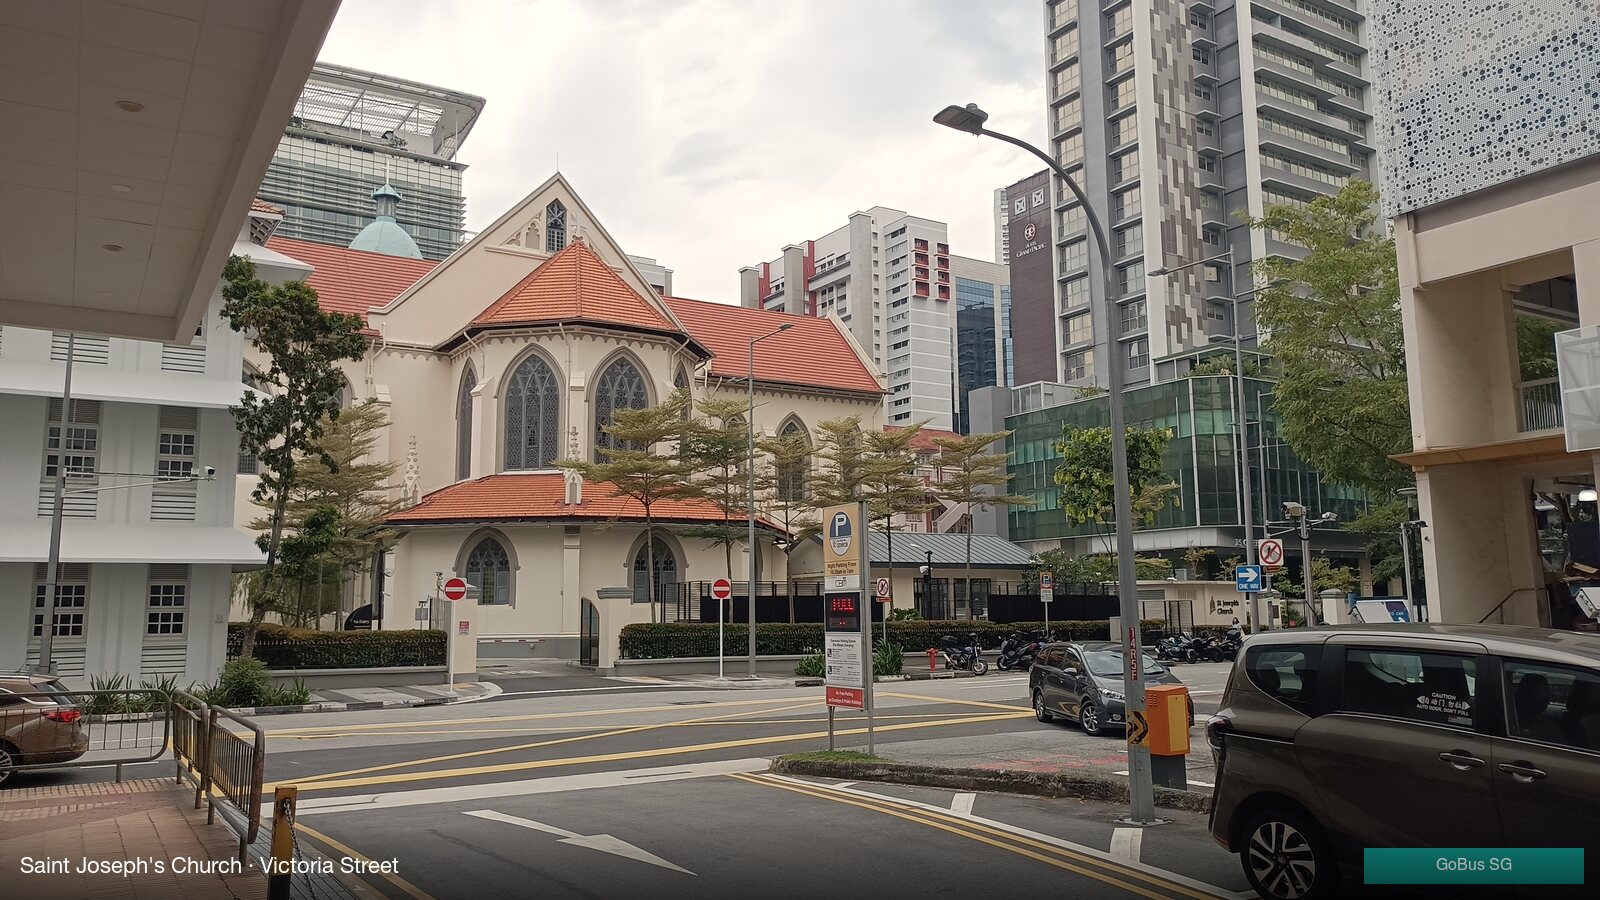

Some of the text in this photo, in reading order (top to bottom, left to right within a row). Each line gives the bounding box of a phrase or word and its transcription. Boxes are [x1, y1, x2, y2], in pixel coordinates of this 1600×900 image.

[835, 514, 847, 537] P
[1216, 607, 1234, 615] Church
[1431, 692, 1457, 700] CAUTION
